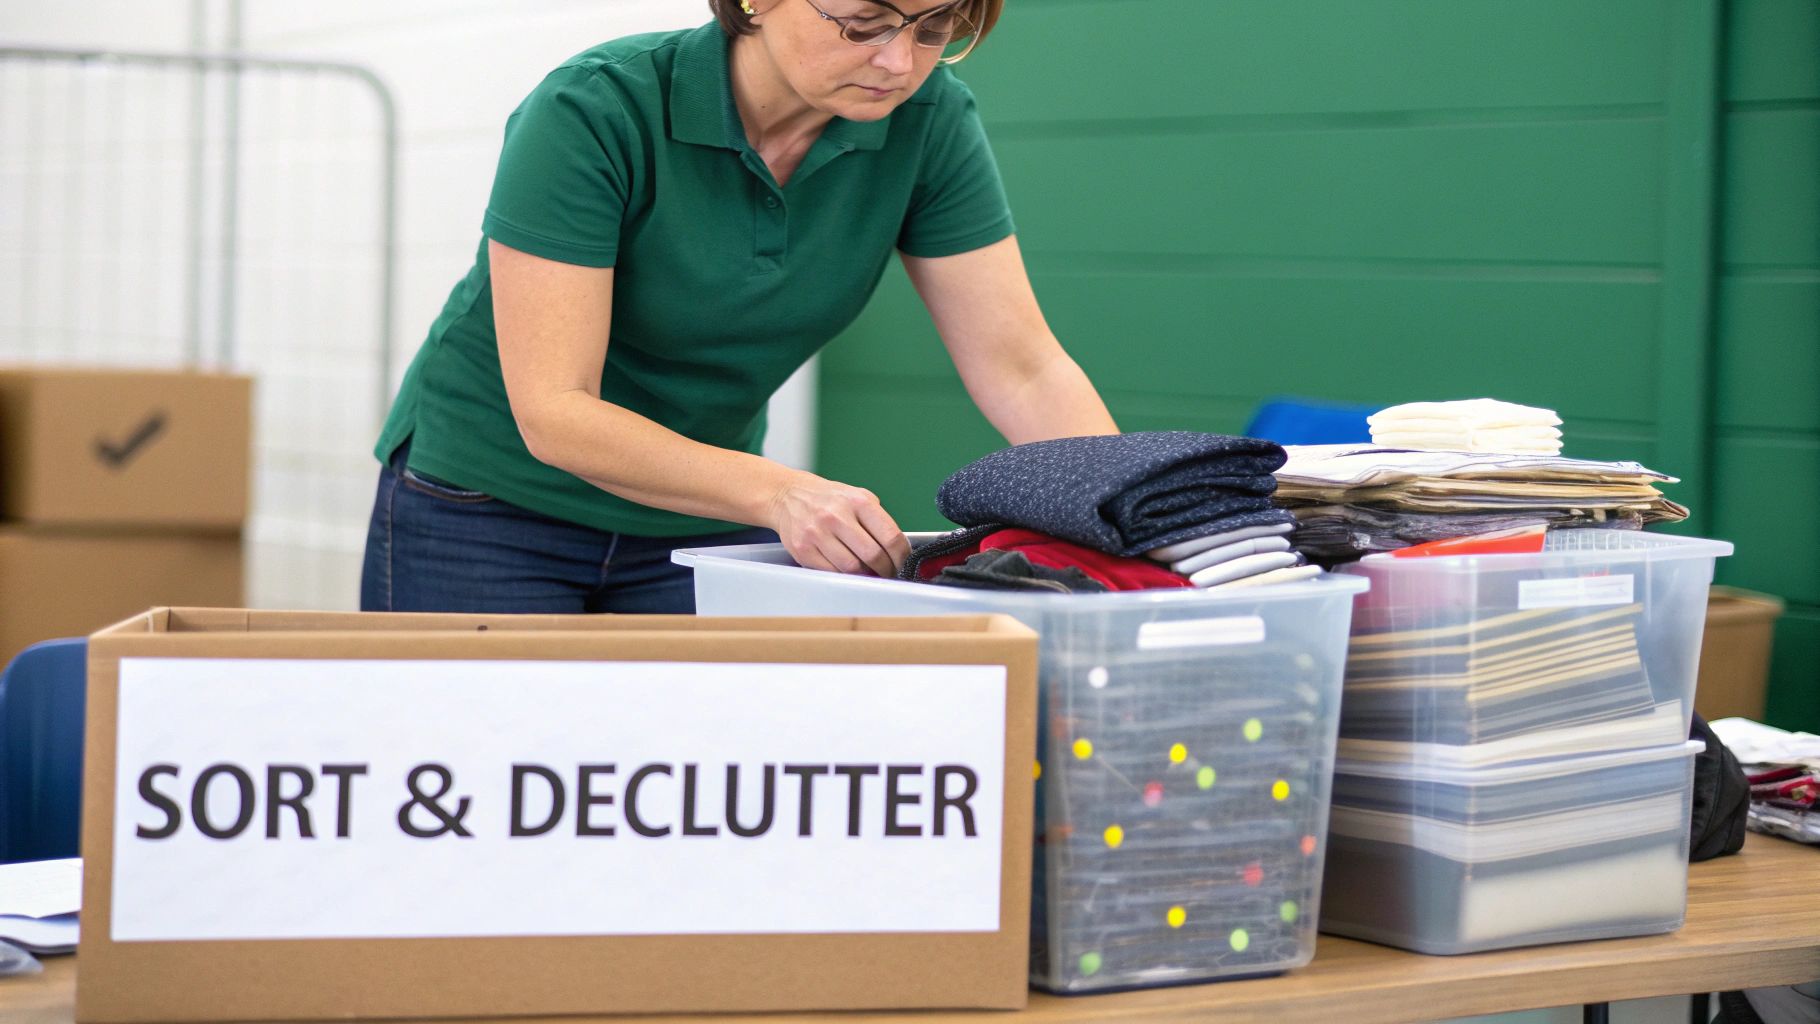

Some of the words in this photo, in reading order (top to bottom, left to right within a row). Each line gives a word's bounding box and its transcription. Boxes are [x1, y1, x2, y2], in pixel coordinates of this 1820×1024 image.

[135, 762, 369, 841] SORT
[396, 762, 475, 840] &
[508, 763, 980, 839] DECLUTTER
